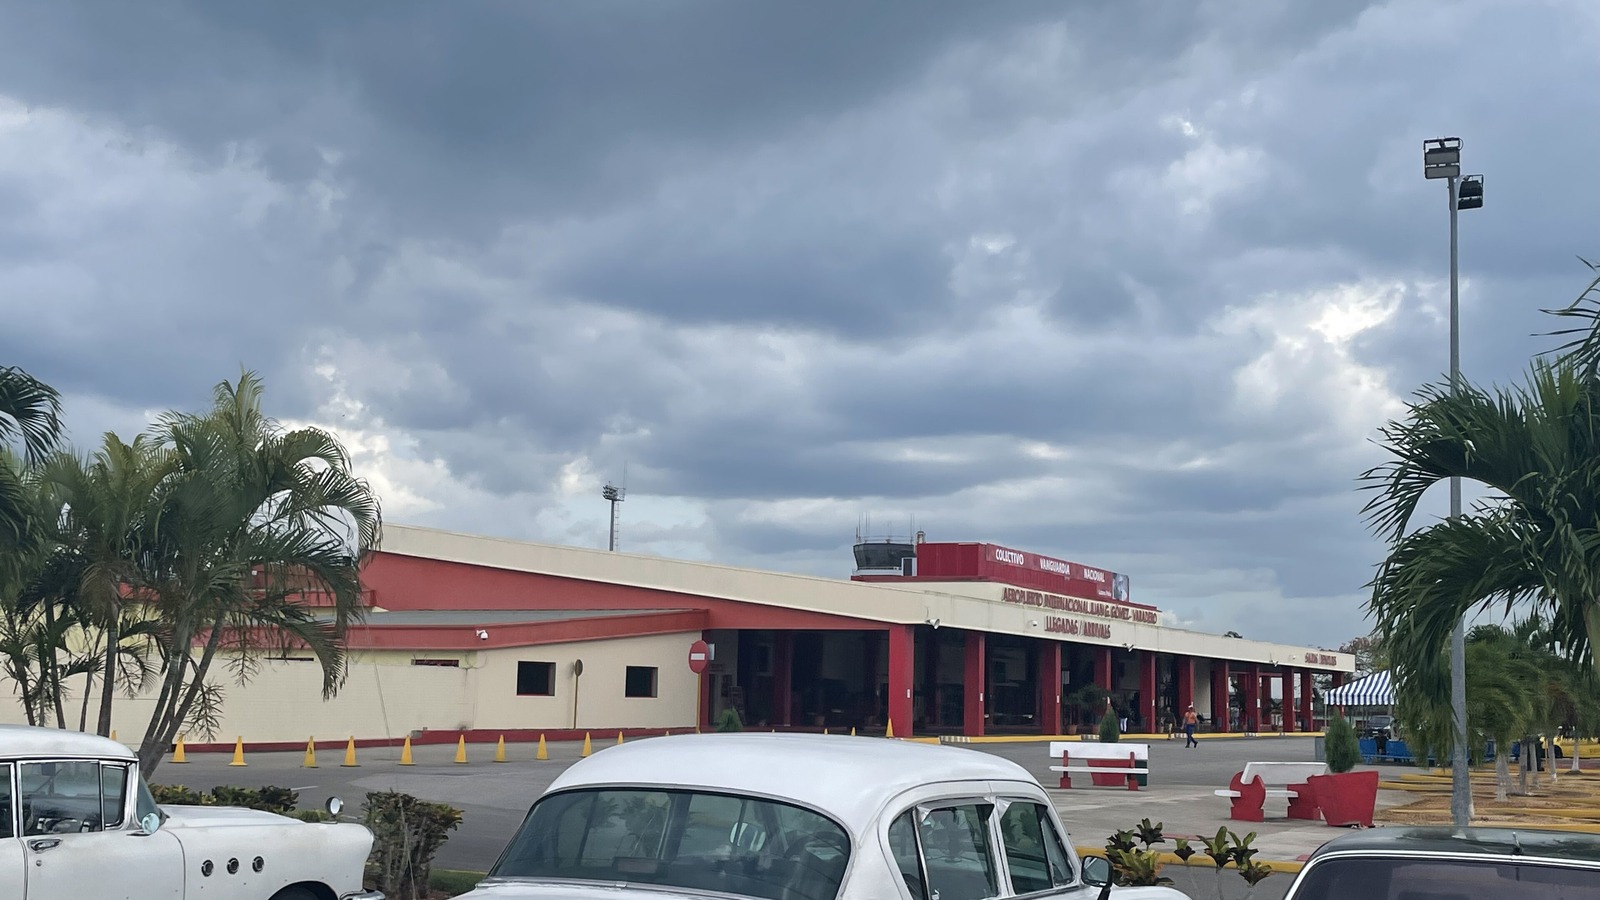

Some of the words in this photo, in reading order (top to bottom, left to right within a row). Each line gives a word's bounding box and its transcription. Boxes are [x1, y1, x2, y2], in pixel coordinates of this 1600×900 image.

[995, 549, 1024, 566] COLECTIVO
[1040, 558, 1070, 575] VANGUARDIA
[1083, 568, 1105, 582] NACIONAL
[1001, 587, 1043, 607] AEROPUERTO
[1044, 593, 1088, 614] INTERNACIONAL
[1132, 608, 1157, 625] VARADERO
[1044, 615, 1078, 635] LLEGADAS
[1083, 621, 1111, 640] ARRIVALS
